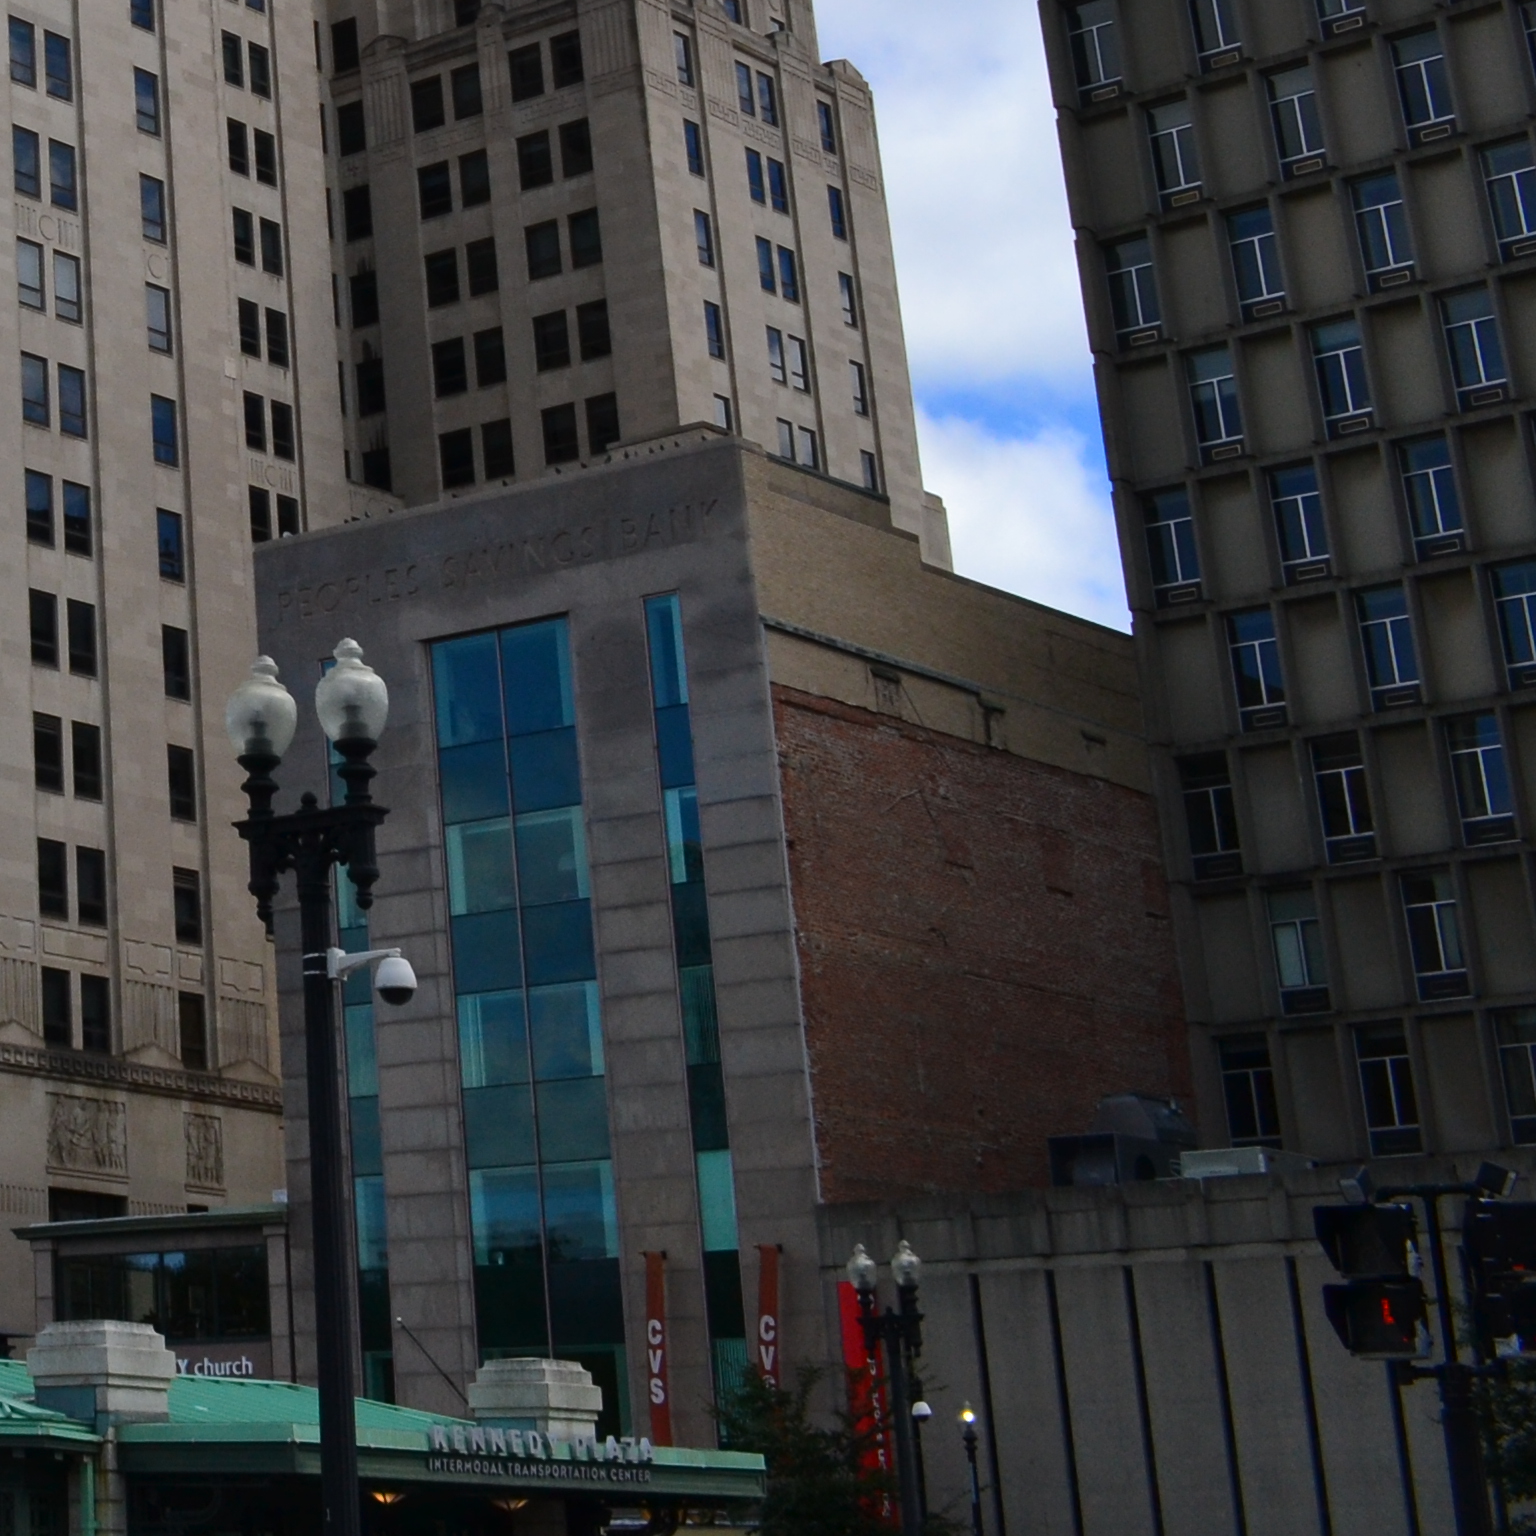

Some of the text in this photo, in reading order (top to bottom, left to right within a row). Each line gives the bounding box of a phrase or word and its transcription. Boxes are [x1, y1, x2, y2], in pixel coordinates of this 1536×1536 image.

[442, 526, 594, 590] SAVINGS
[620, 498, 720, 550] BANK
[194, 1356, 254, 1376] church
[648, 1319, 666, 1404] CVS
[430, 1424, 654, 1464] KENNEDY PLAZA
[429, 1458, 652, 1482] INTERMODAL TRANSPORTATION CENTER
